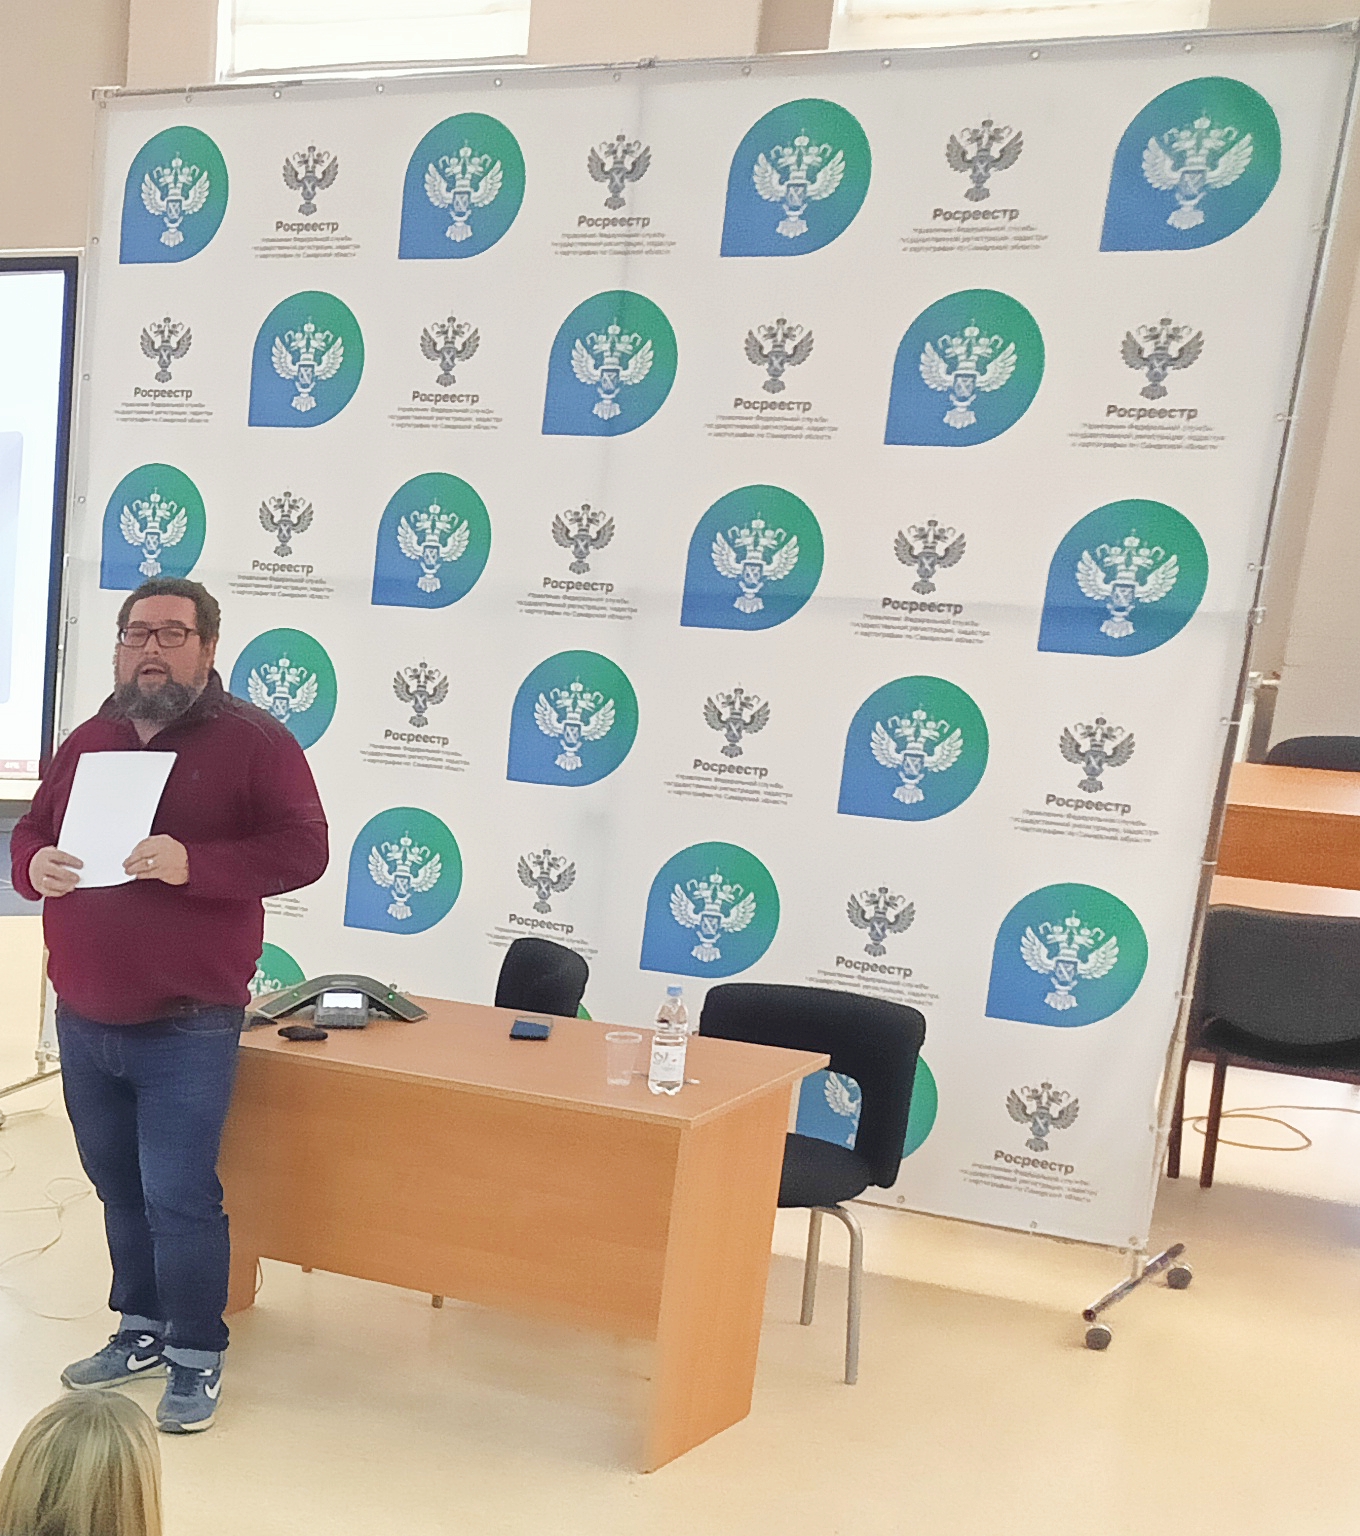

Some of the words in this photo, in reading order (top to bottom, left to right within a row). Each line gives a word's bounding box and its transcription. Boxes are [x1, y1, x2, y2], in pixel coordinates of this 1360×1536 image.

[577, 215, 651, 229] Росреестр
[932, 208, 1020, 223] Росреестр
[275, 220, 339, 235] Росреестр
[133, 386, 193, 401] Росреестр
[412, 390, 480, 406] Росреестр
[733, 397, 812, 413] Росреестр
[1106, 404, 1198, 421] Росреестр
[252, 559, 314, 577] Росреестр
[542, 577, 614, 595] Росреестр
[882, 597, 963, 616] Росреестр
[384, 729, 449, 748] Росреестр
[693, 758, 769, 779] Росреестр
[1045, 793, 1132, 816] Росреестр
[509, 913, 574, 935] Росреестр
[836, 956, 913, 979] Росреестр
[994, 1150, 1074, 1176] Росреестр
